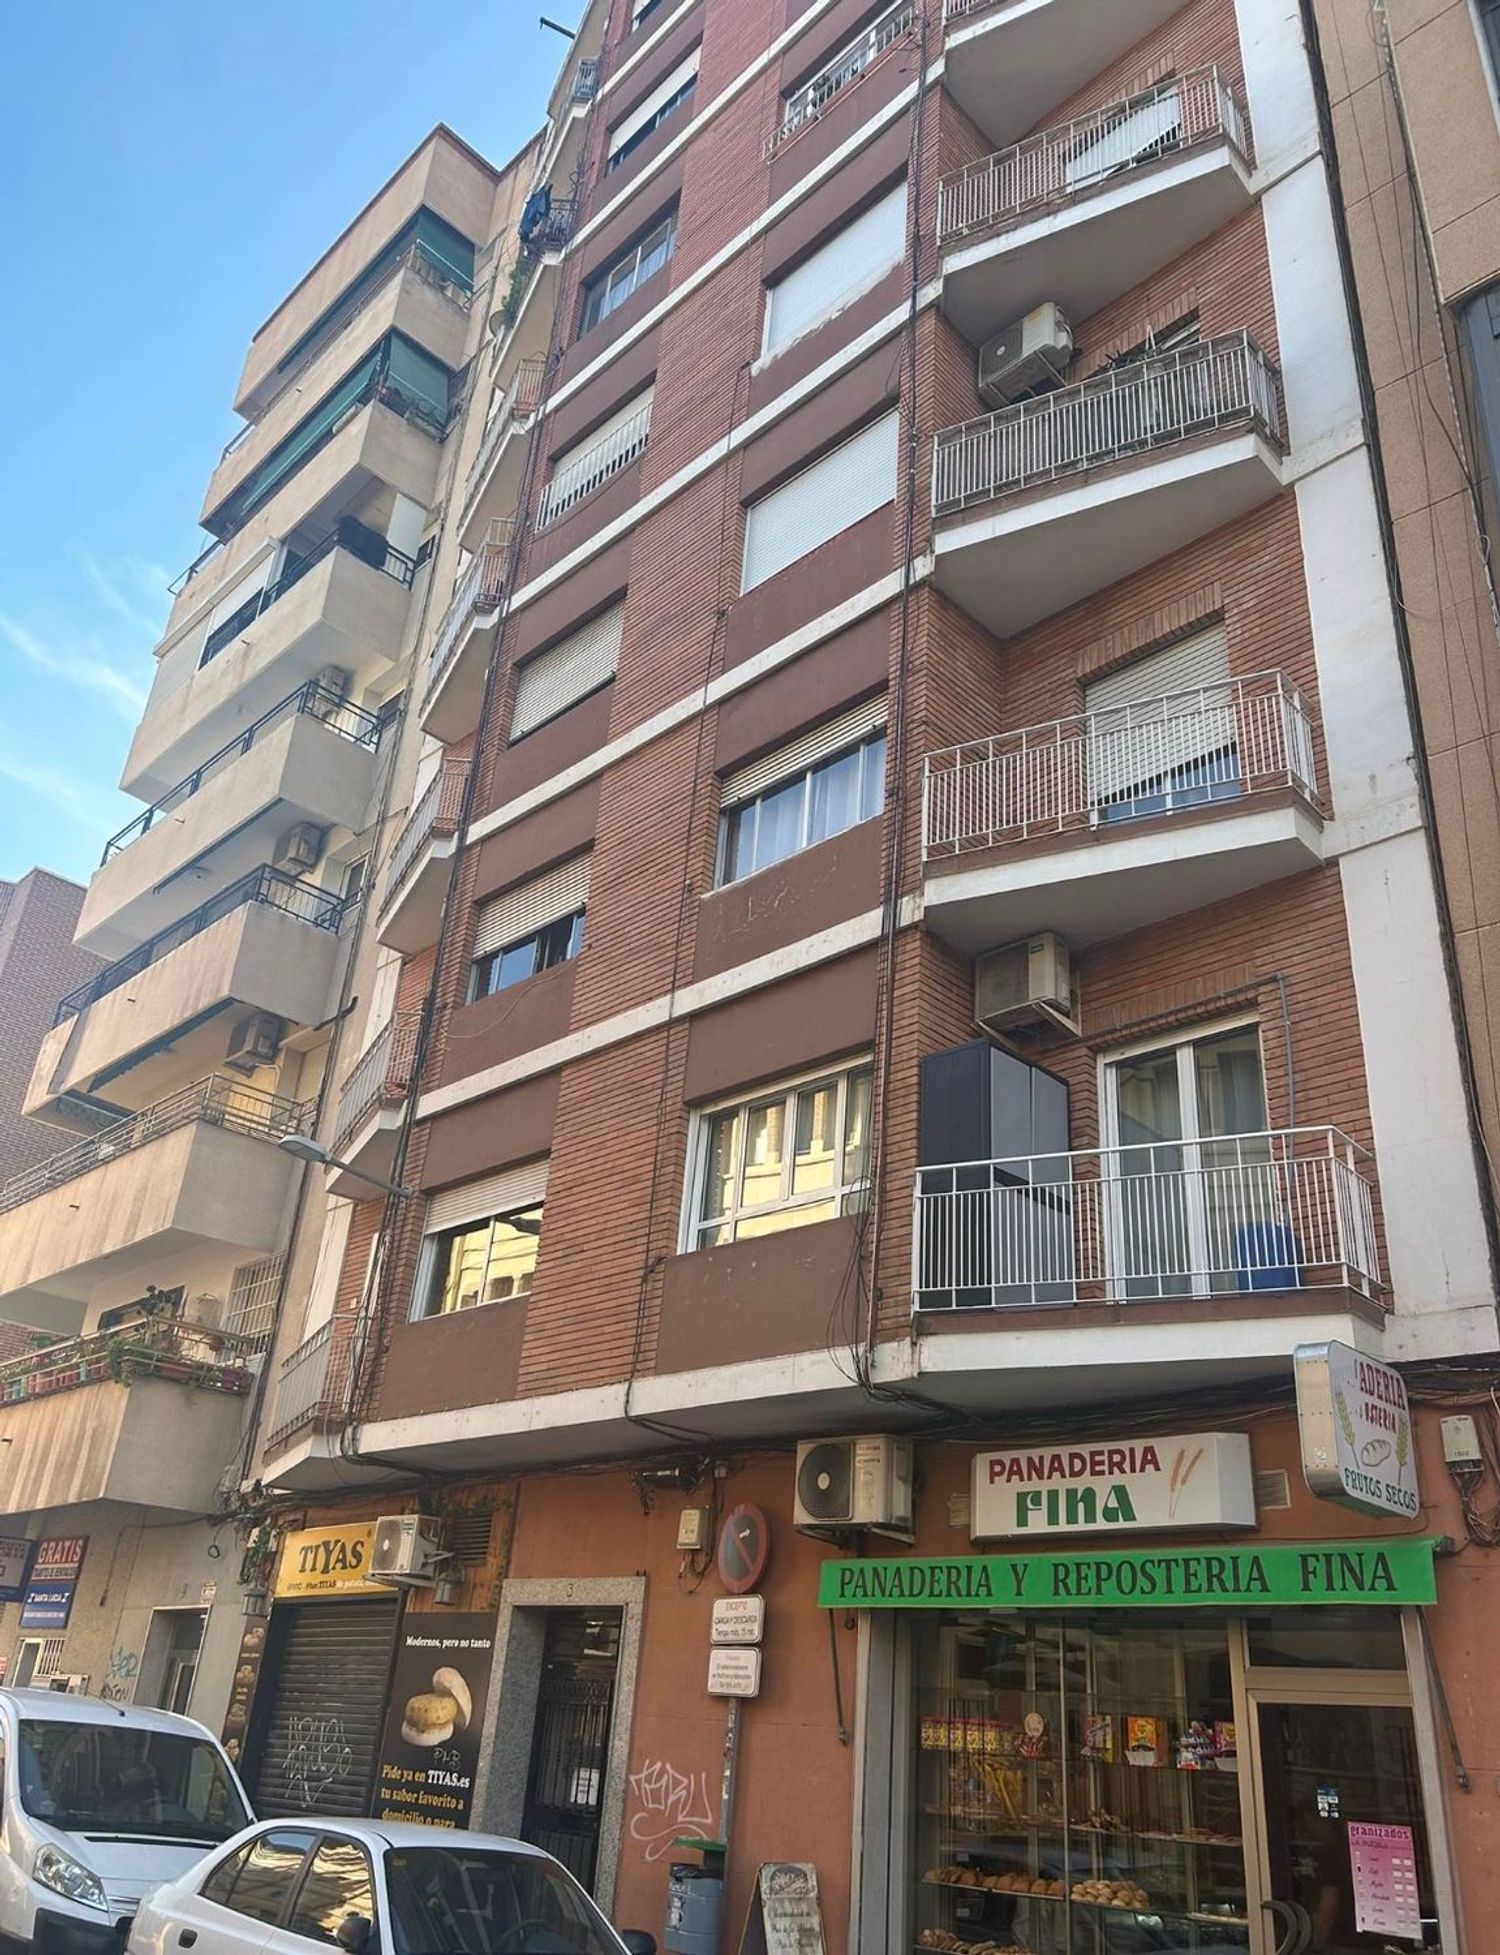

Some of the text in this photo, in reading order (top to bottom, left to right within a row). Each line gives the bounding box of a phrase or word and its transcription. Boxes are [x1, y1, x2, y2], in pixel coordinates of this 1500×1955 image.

[989, 1445, 1162, 1485] PANADERIA
[1344, 1467, 1417, 1512] FRUTOS SECOS
[38, 1539, 84, 1564] GRATIS
[298, 1538, 365, 1575] TIYAS
[839, 1551, 1397, 1599] PANADERIA Y REPOSTERIA FINA
[442, 1639, 460, 1649] pero
[460, 1639, 470, 1648] no
[470, 1637, 491, 1649] tanto
[381, 1764, 471, 1788] Pide ya en TIYAS.es
[381, 1787, 465, 1810] tu sabor favorito a
[382, 1807, 424, 1825] domicilio
